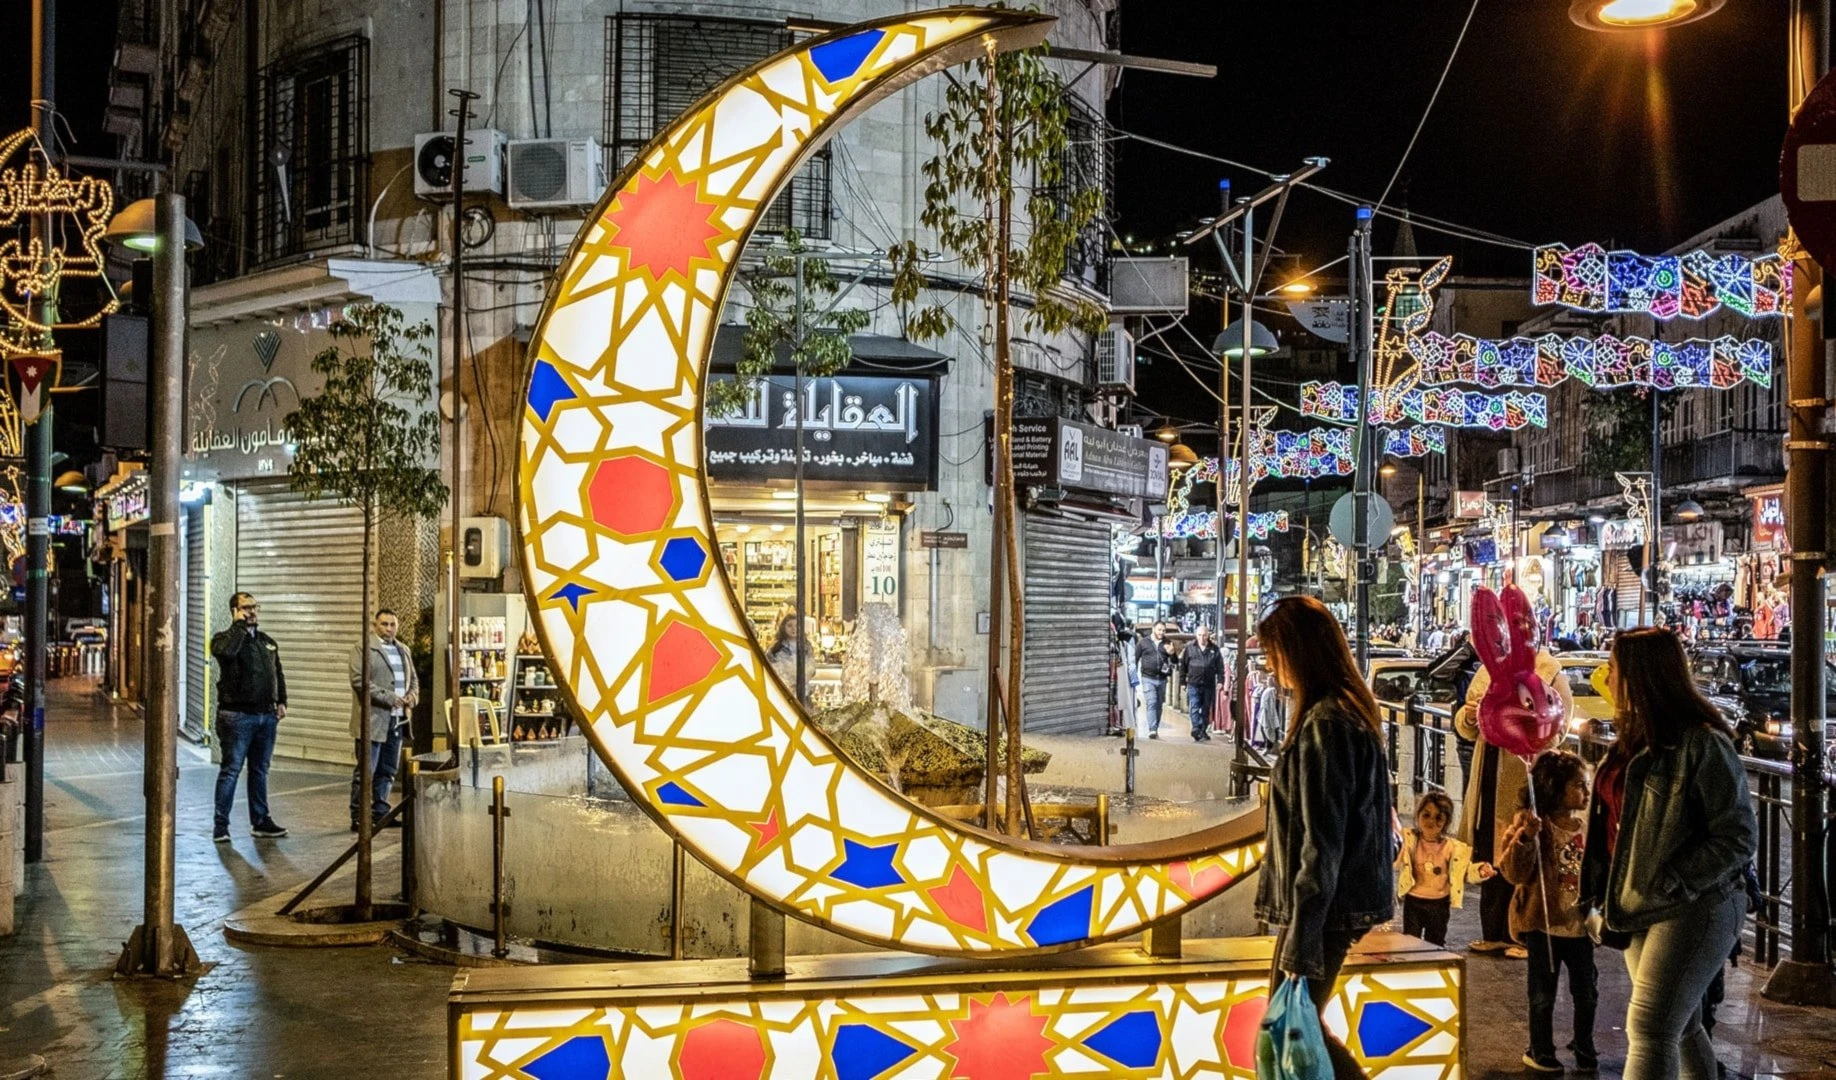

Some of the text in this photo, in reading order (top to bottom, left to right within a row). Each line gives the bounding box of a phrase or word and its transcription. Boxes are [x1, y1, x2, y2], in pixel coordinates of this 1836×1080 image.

[777, 378, 919, 444] العقايلة
[241, 417, 285, 454] مأمون
[1018, 424, 1047, 433] Service
[192, 426, 240, 458] العقايلة
[1031, 436, 1052, 444] Battery
[1106, 440, 1127, 454] عدنان
[709, 450, 737, 465] جميع
[739, 448, 779, 465] وتركيب
[1063, 440, 1079, 462] AAL
[817, 452, 844, 467] بخور
[852, 452, 883, 468] مباخر
[872, 575, 896, 595] 10
